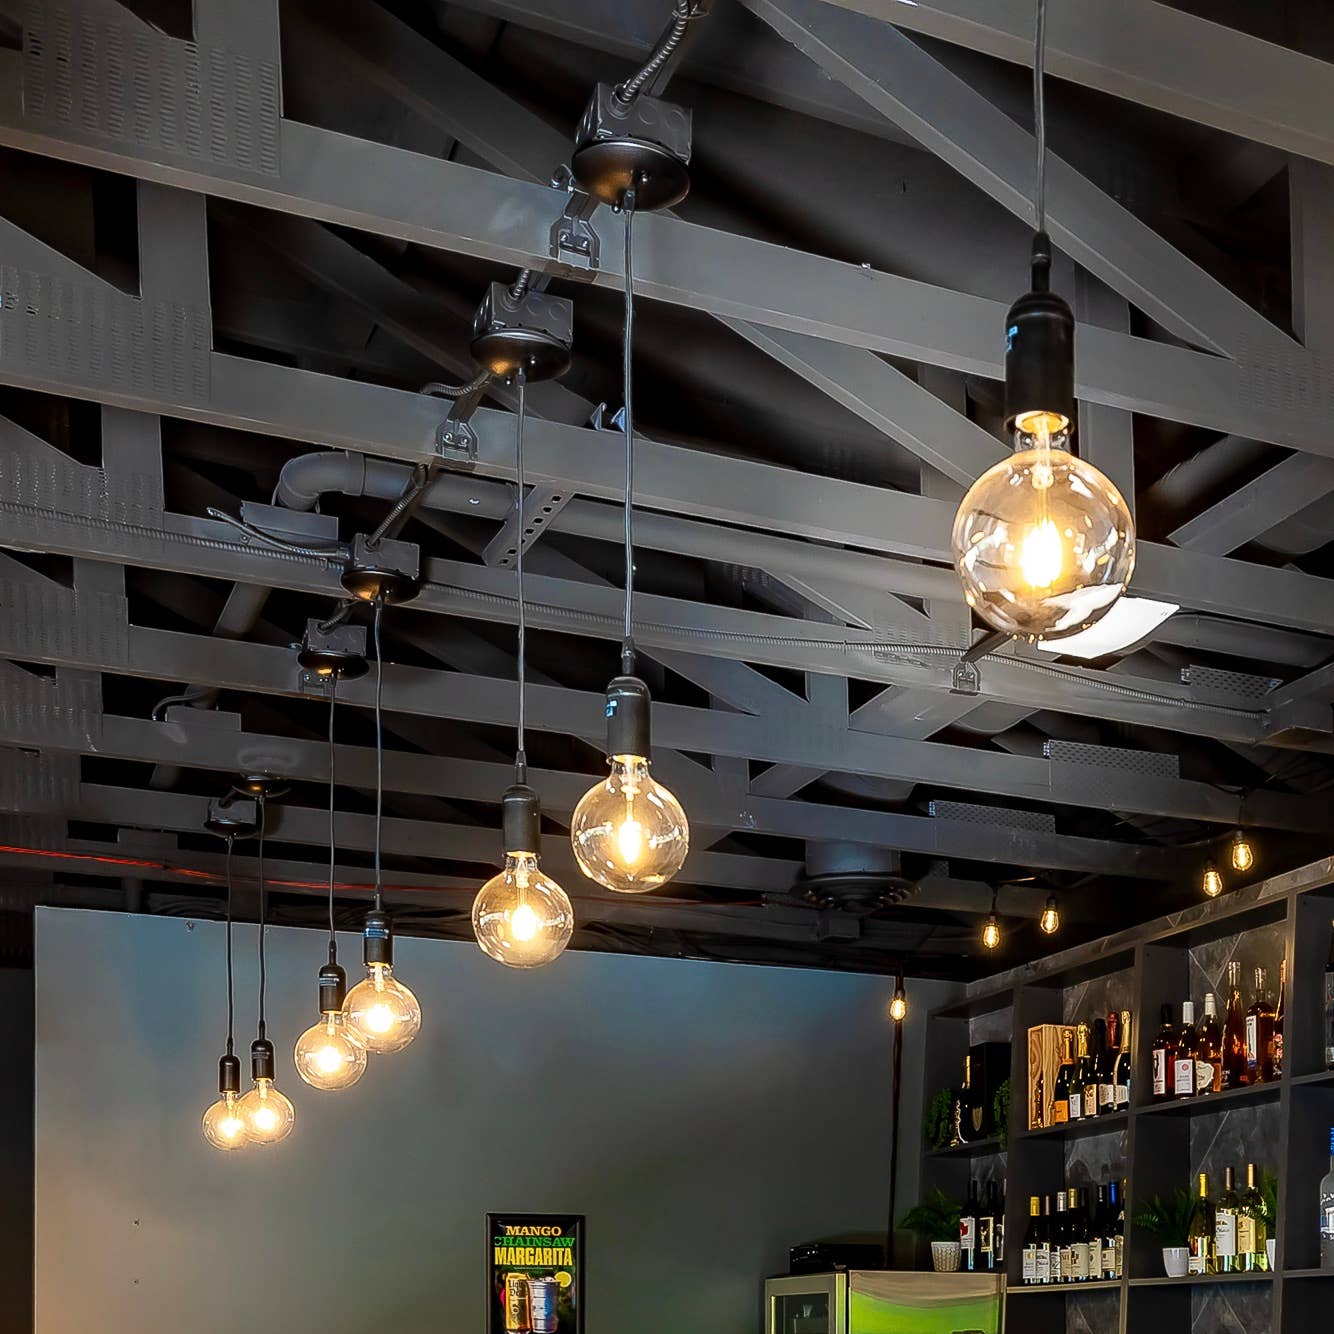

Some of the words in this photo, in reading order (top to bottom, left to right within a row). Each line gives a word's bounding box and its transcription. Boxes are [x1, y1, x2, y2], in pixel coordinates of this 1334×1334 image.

[505, 1225, 562, 1237] MANGO
[494, 1236, 576, 1247] CHAINSAW
[494, 1247, 573, 1267] MARGARITA
